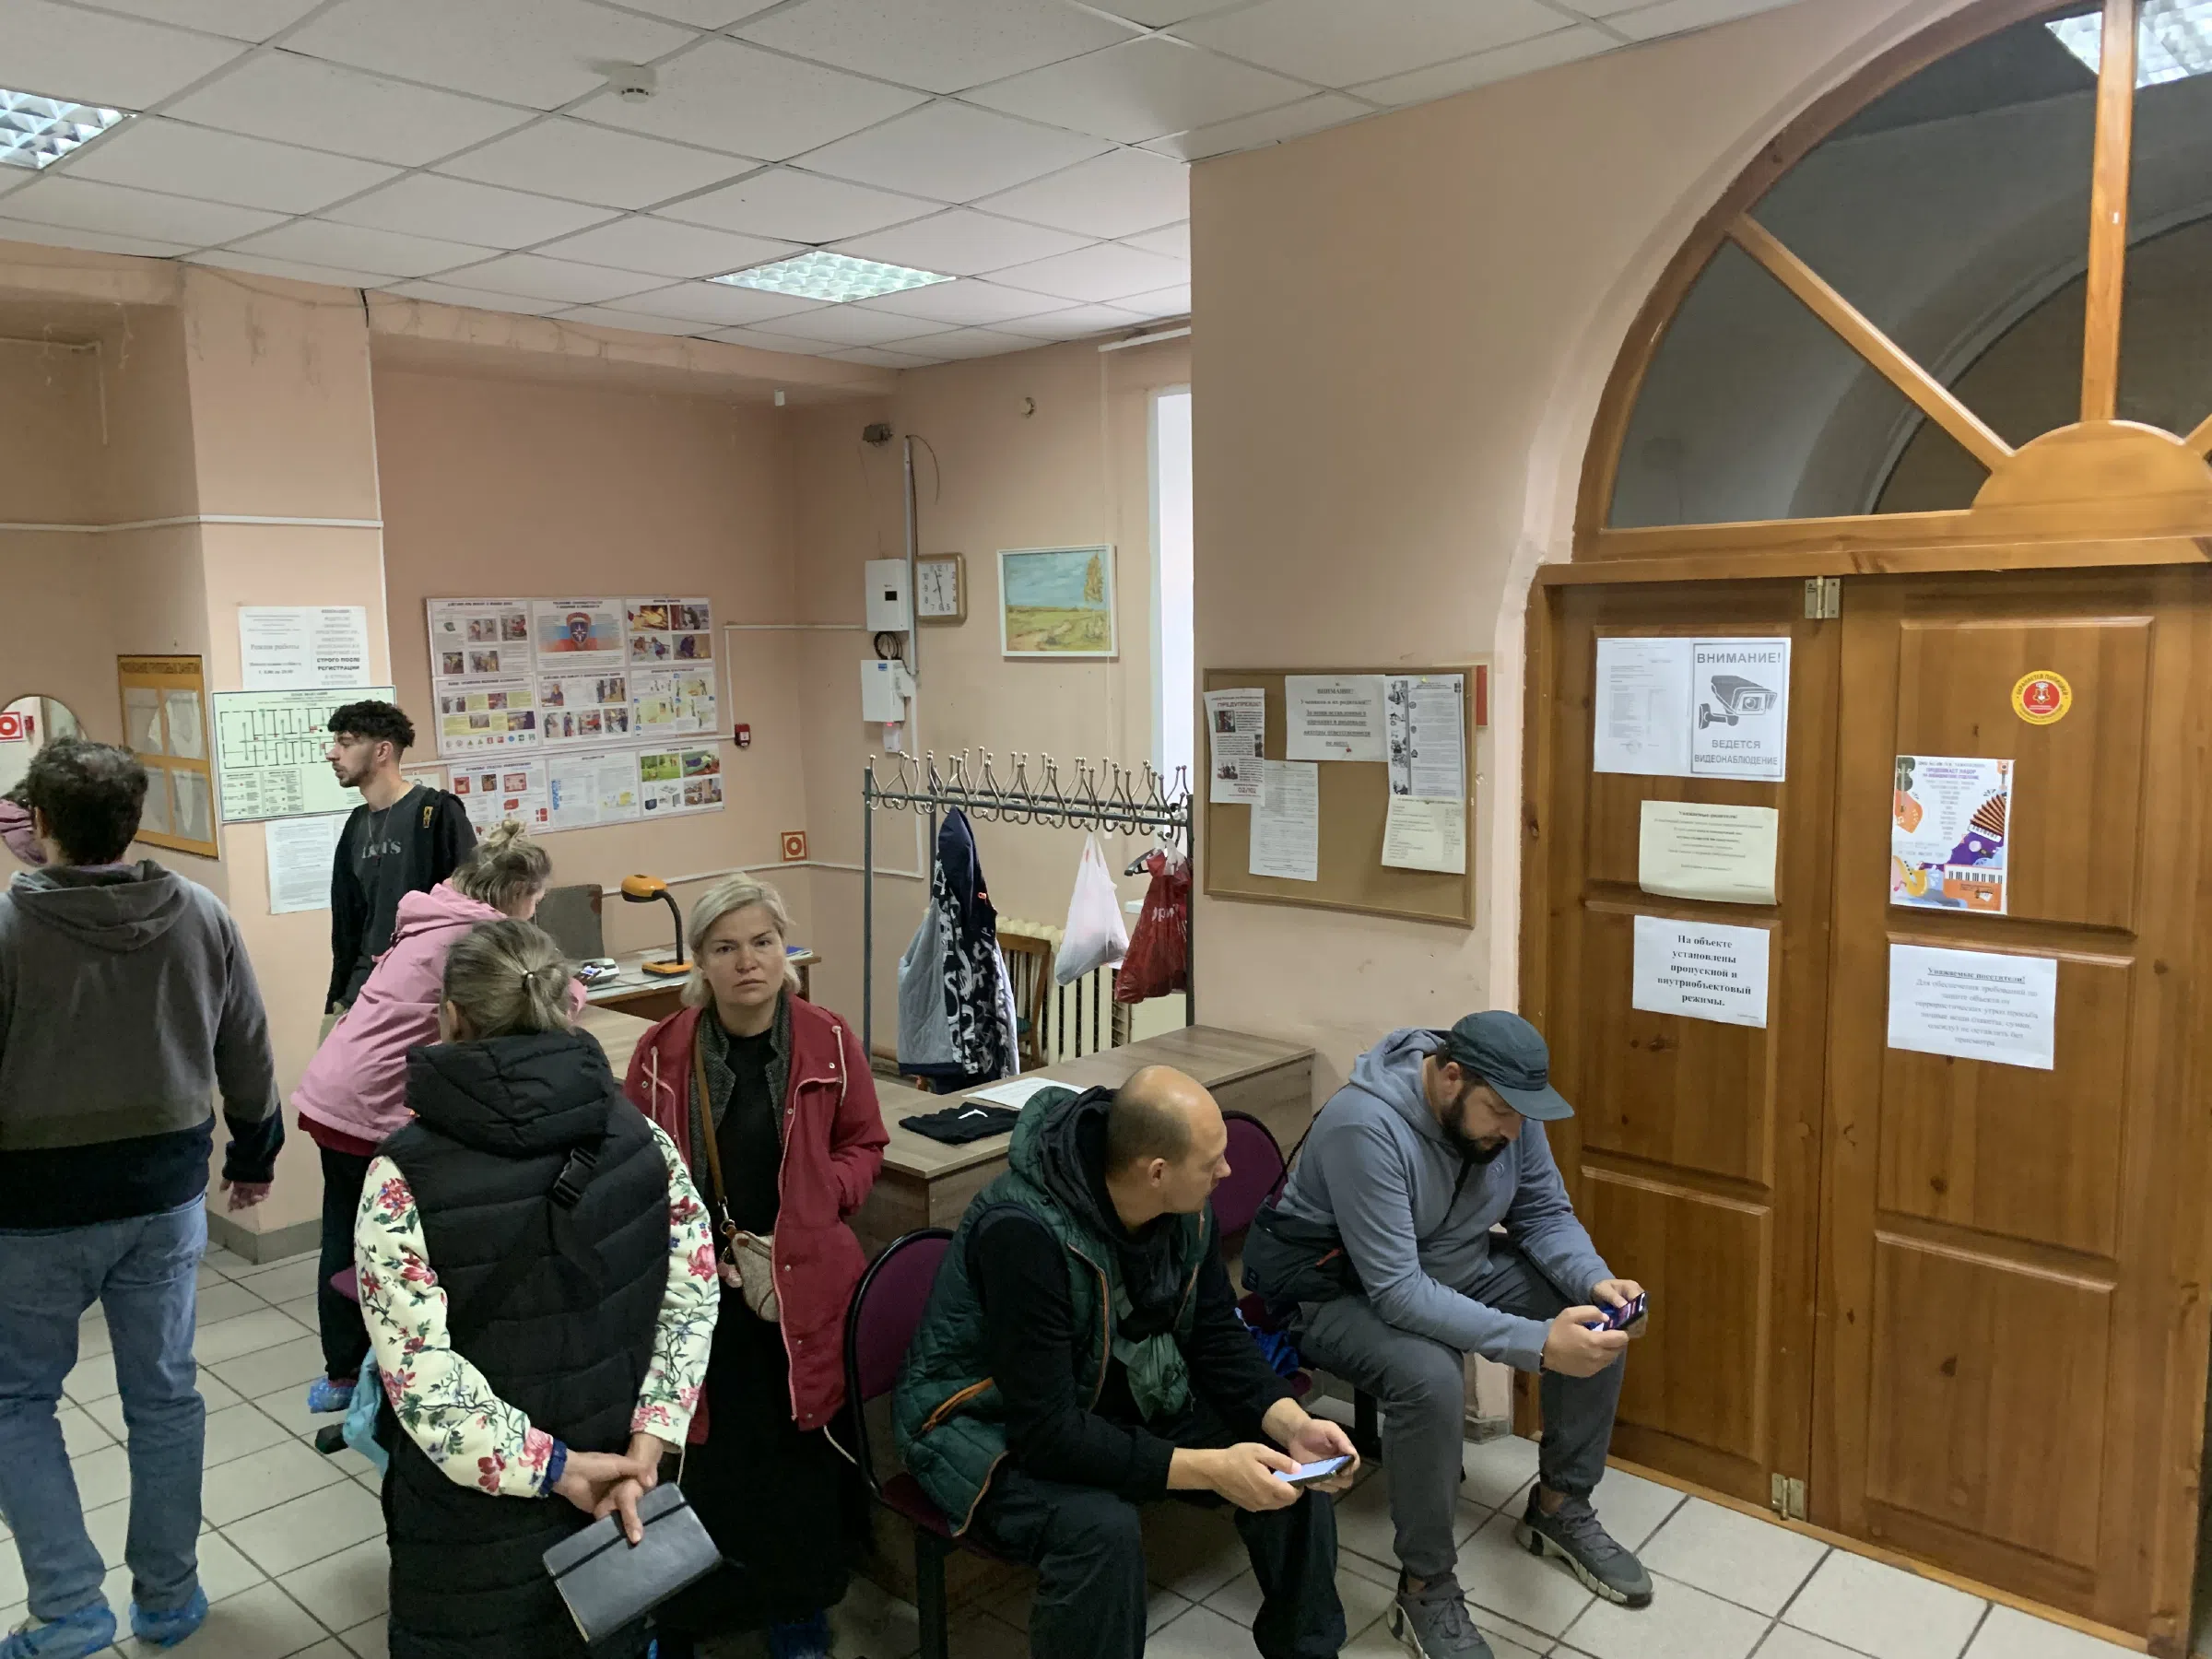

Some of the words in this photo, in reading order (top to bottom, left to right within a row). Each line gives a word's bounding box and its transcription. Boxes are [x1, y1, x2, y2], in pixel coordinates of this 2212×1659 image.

[1697, 653, 1782, 664] ВНИМАНИЕ!
[1712, 739, 1761, 749] ВЕДЕТСЯ
[1694, 754, 1779, 766] ВИДЕОНАБЛЮДЕНИЕ
[1677, 935, 1691, 944] На
[1693, 936, 1733, 948] объекте
[1672, 950, 1736, 963] установлены
[1670, 964, 1728, 977] пропускной
[1927, 967, 1974, 980] Уважаемые
[1975, 973, 2026, 984] посетители!
[1657, 977, 1751, 994] внутриобъектовый
[1915, 978, 1931, 986] Для
[1682, 994, 1725, 1006] режимы.
[1914, 1000, 1983, 1013] террористических
